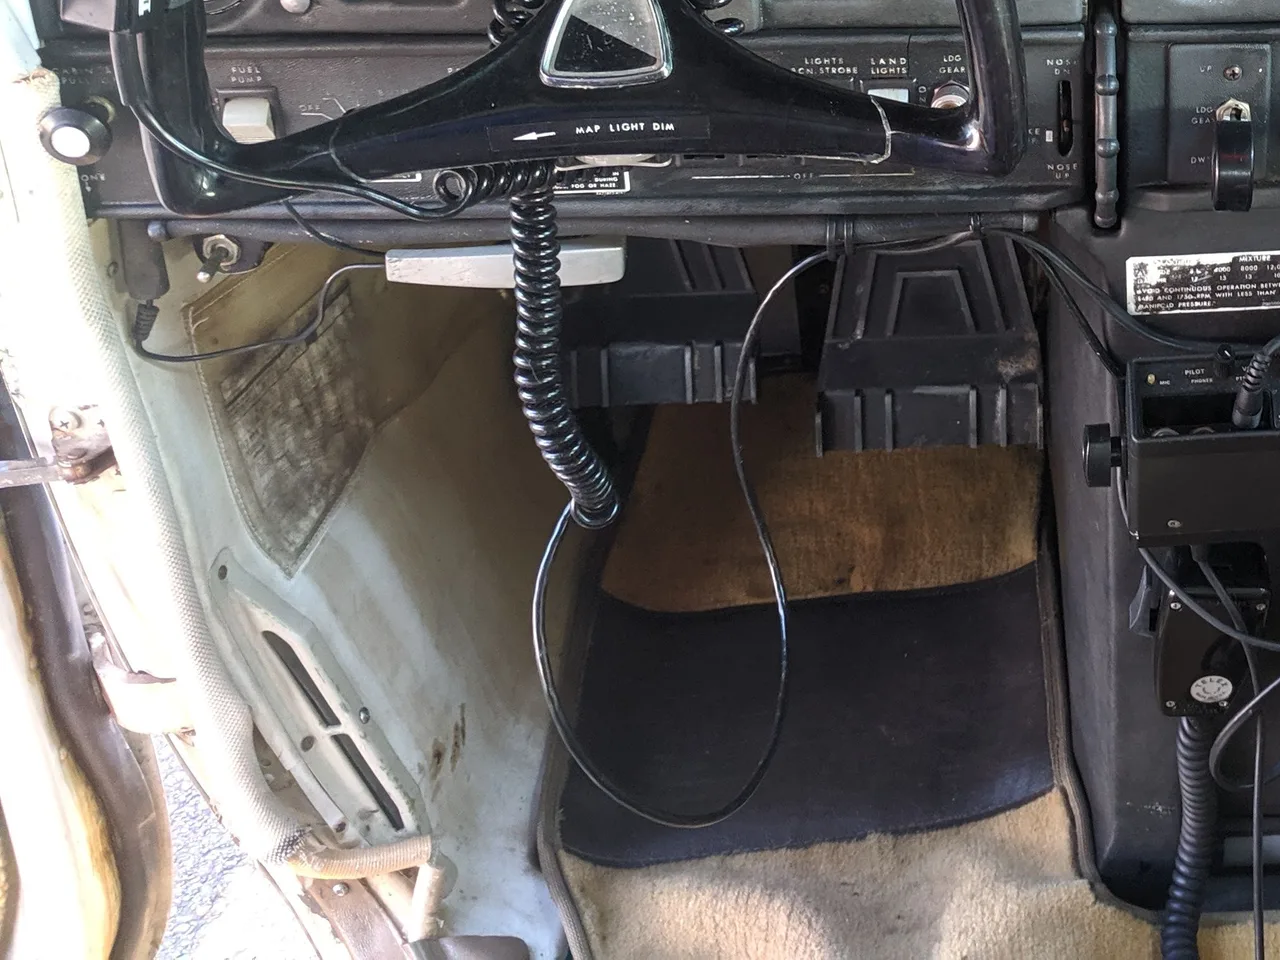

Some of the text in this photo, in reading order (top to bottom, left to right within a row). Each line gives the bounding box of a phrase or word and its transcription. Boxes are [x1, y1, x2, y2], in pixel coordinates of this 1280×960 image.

[804, 57, 844, 65] LIGHTS
[943, 54, 962, 63] LDG
[231, 66, 260, 74] FUEL
[575, 122, 675, 134] MAP LIGHT DIM
[1164, 285, 1212, 293] CONTINUOUS
[1216, 283, 1257, 291] OPERATION
[1184, 368, 1205, 376] PILOT
